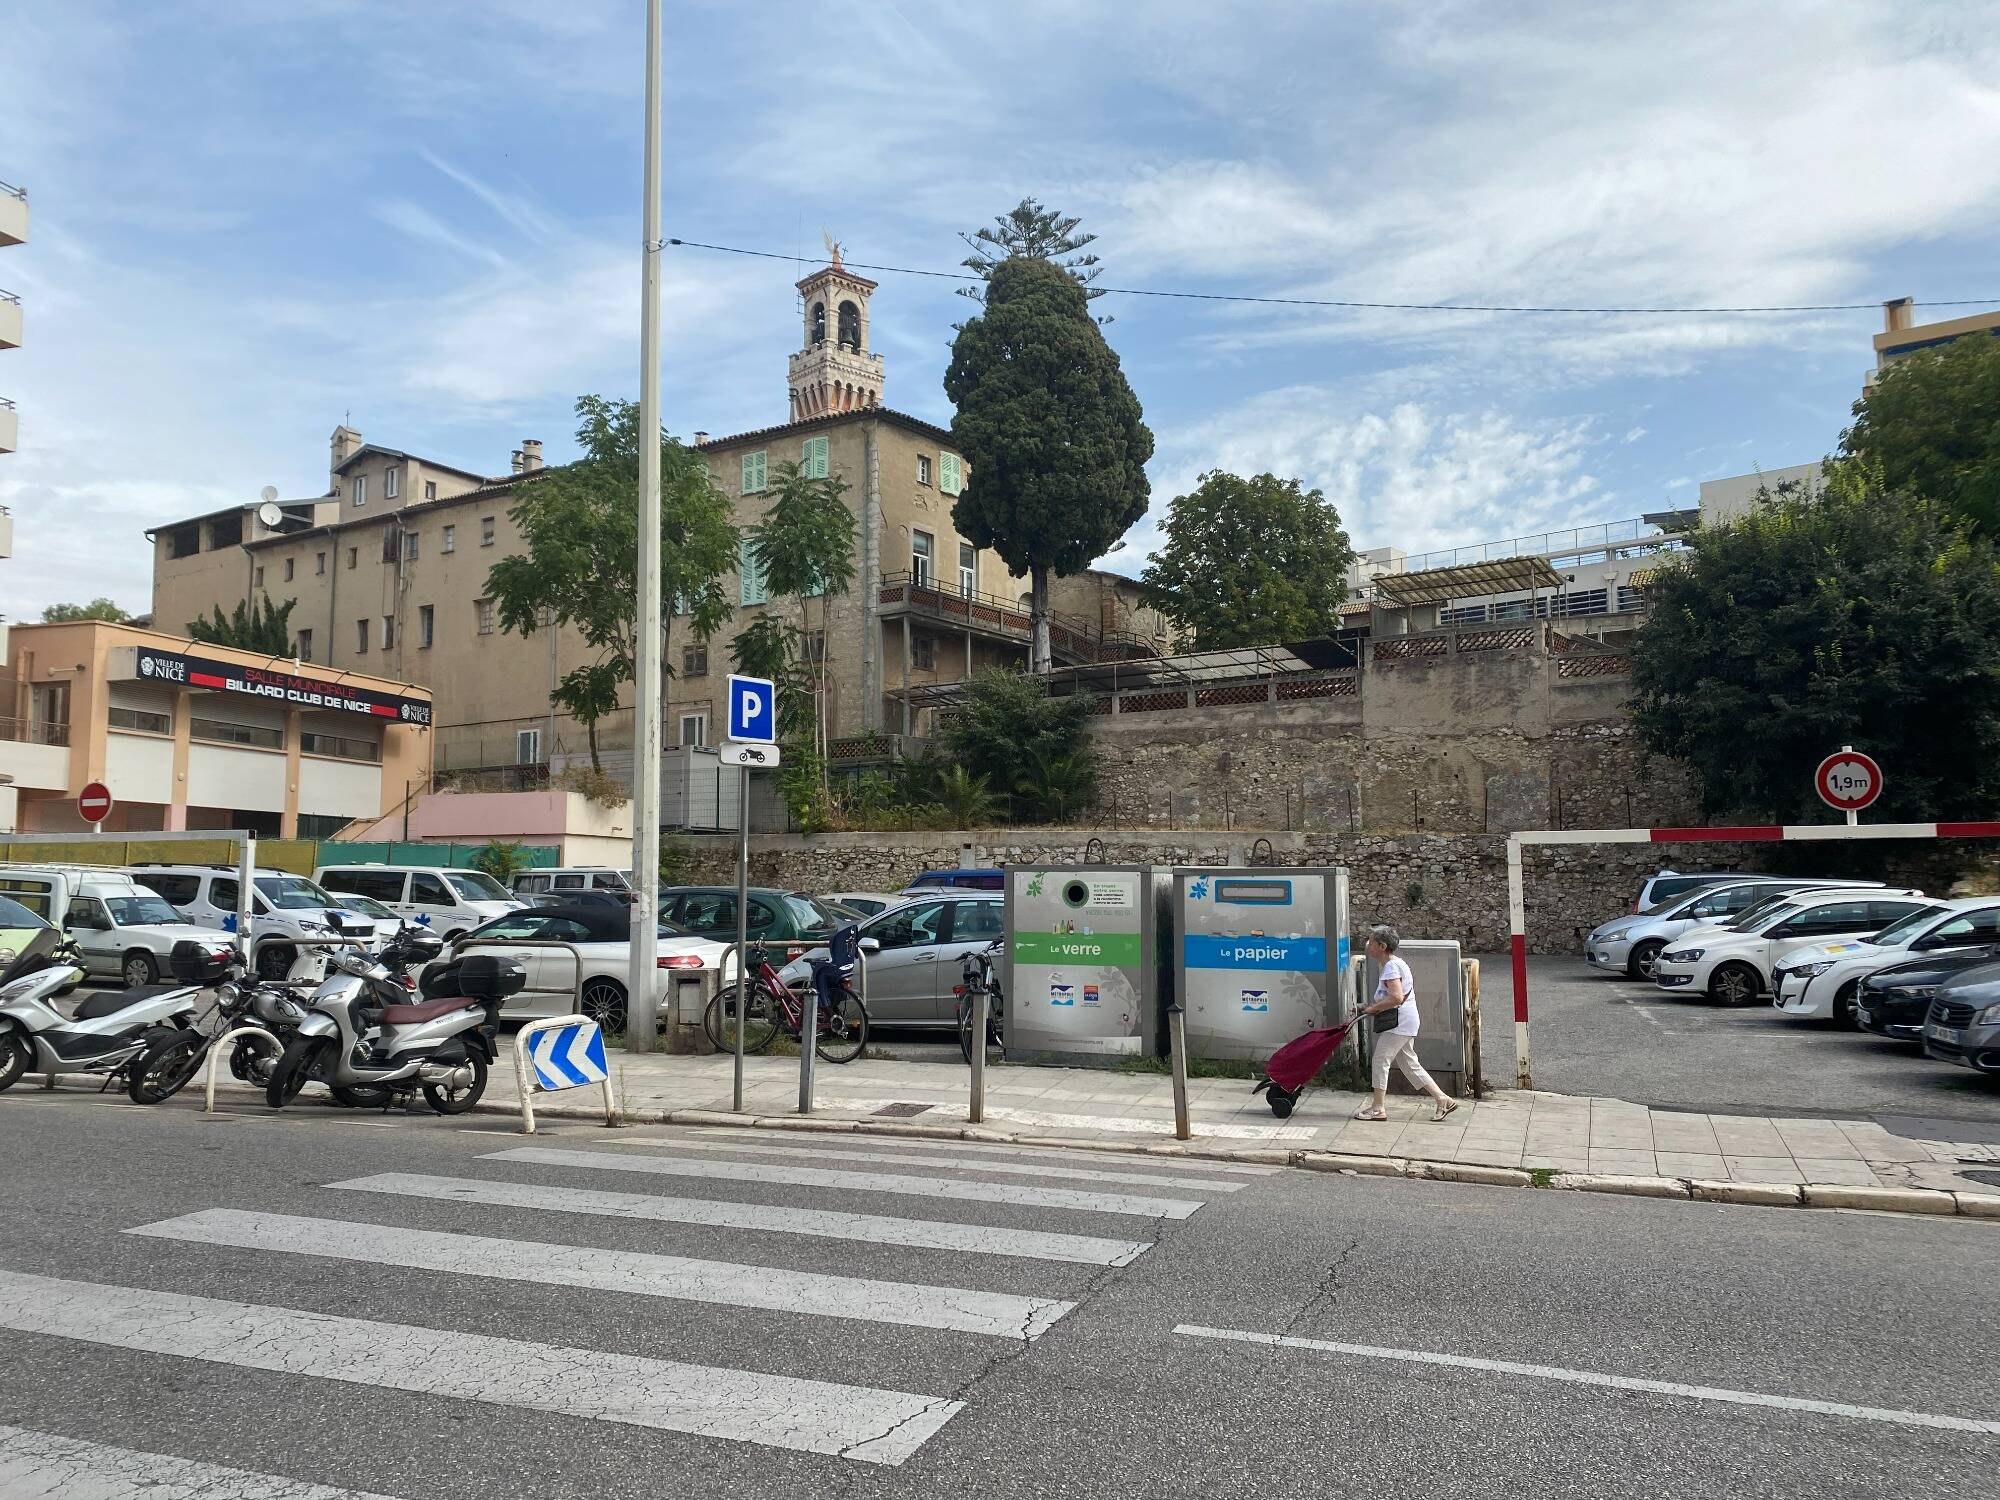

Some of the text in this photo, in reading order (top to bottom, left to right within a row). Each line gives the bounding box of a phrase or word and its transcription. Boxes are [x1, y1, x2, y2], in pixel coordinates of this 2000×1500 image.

[155, 658, 184, 670] VILLE DE
[155, 665, 184, 681] NICE
[245, 669, 357, 699] SALLE MUNICIPALE
[226, 678, 371, 714] BILLARD CLUB DE NICE
[410, 704, 422, 712] VILLE
[742, 690, 762, 729] P
[410, 711, 430, 723] NICE
[1050, 944, 1101, 956] Le verre
[1220, 946, 1288, 962] Le papier
